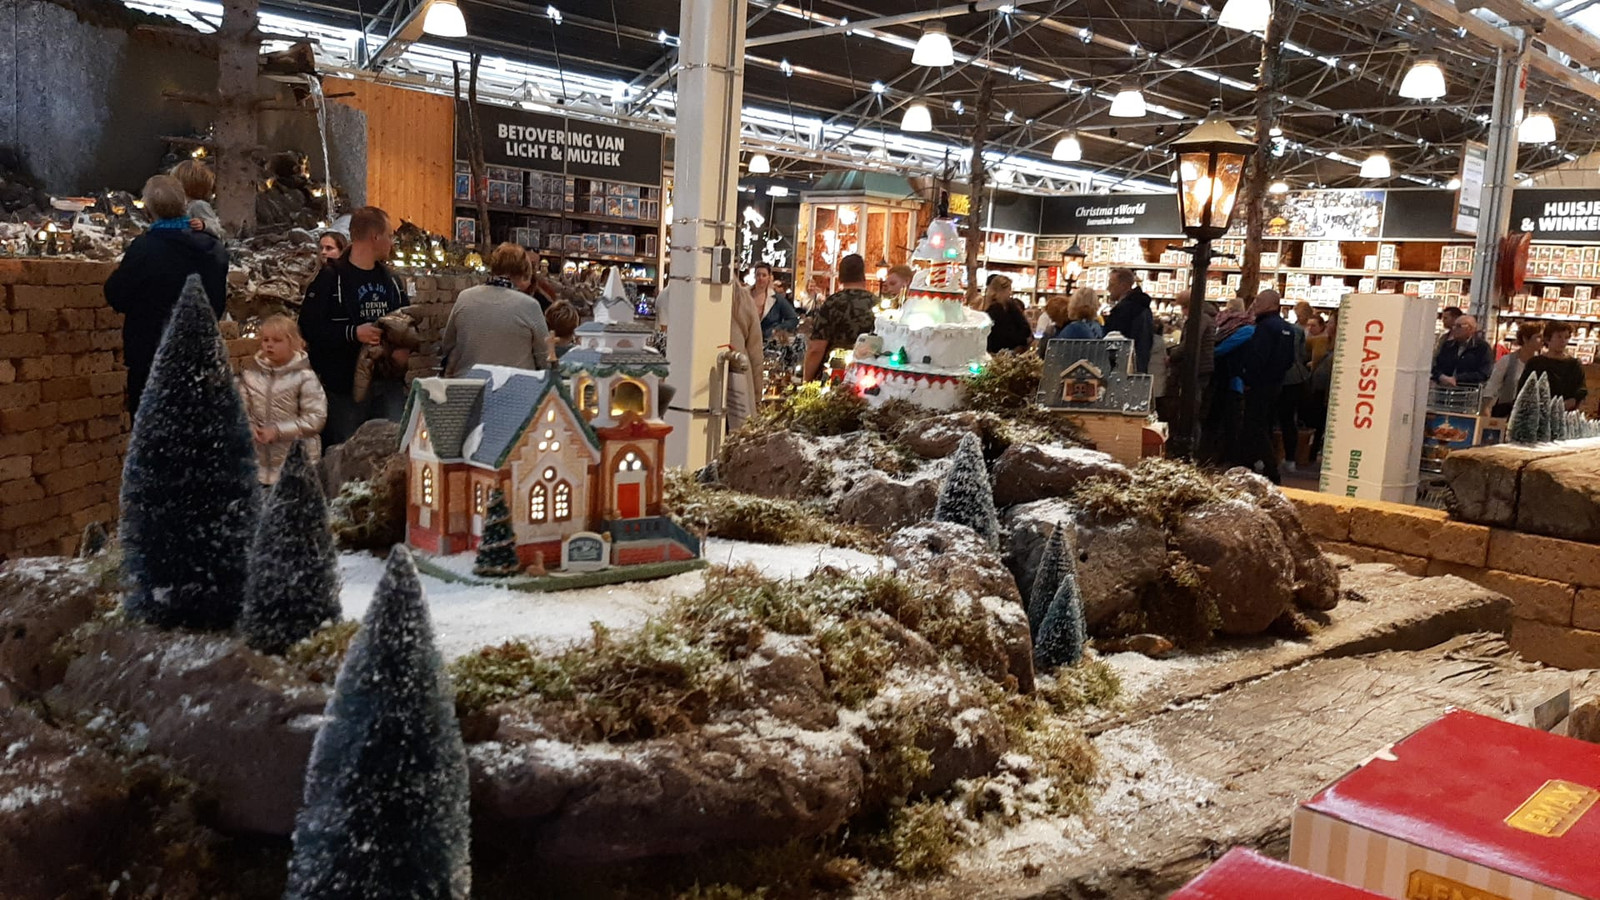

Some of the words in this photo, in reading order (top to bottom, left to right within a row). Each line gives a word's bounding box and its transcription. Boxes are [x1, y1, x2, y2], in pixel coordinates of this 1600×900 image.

[498, 123, 592, 147] BETOVERING
[596, 135, 625, 152] VAN
[506, 142, 546, 160] LICHT
[551, 146, 562, 160] &
[567, 149, 620, 167] MUZIEK
[1520, 217, 1535, 232] &
[1538, 216, 1600, 231] WINKE
[359, 308, 389, 317] SUPPL
[365, 301, 388, 309] DENIM
[1354, 320, 1384, 430] CLASSICS
